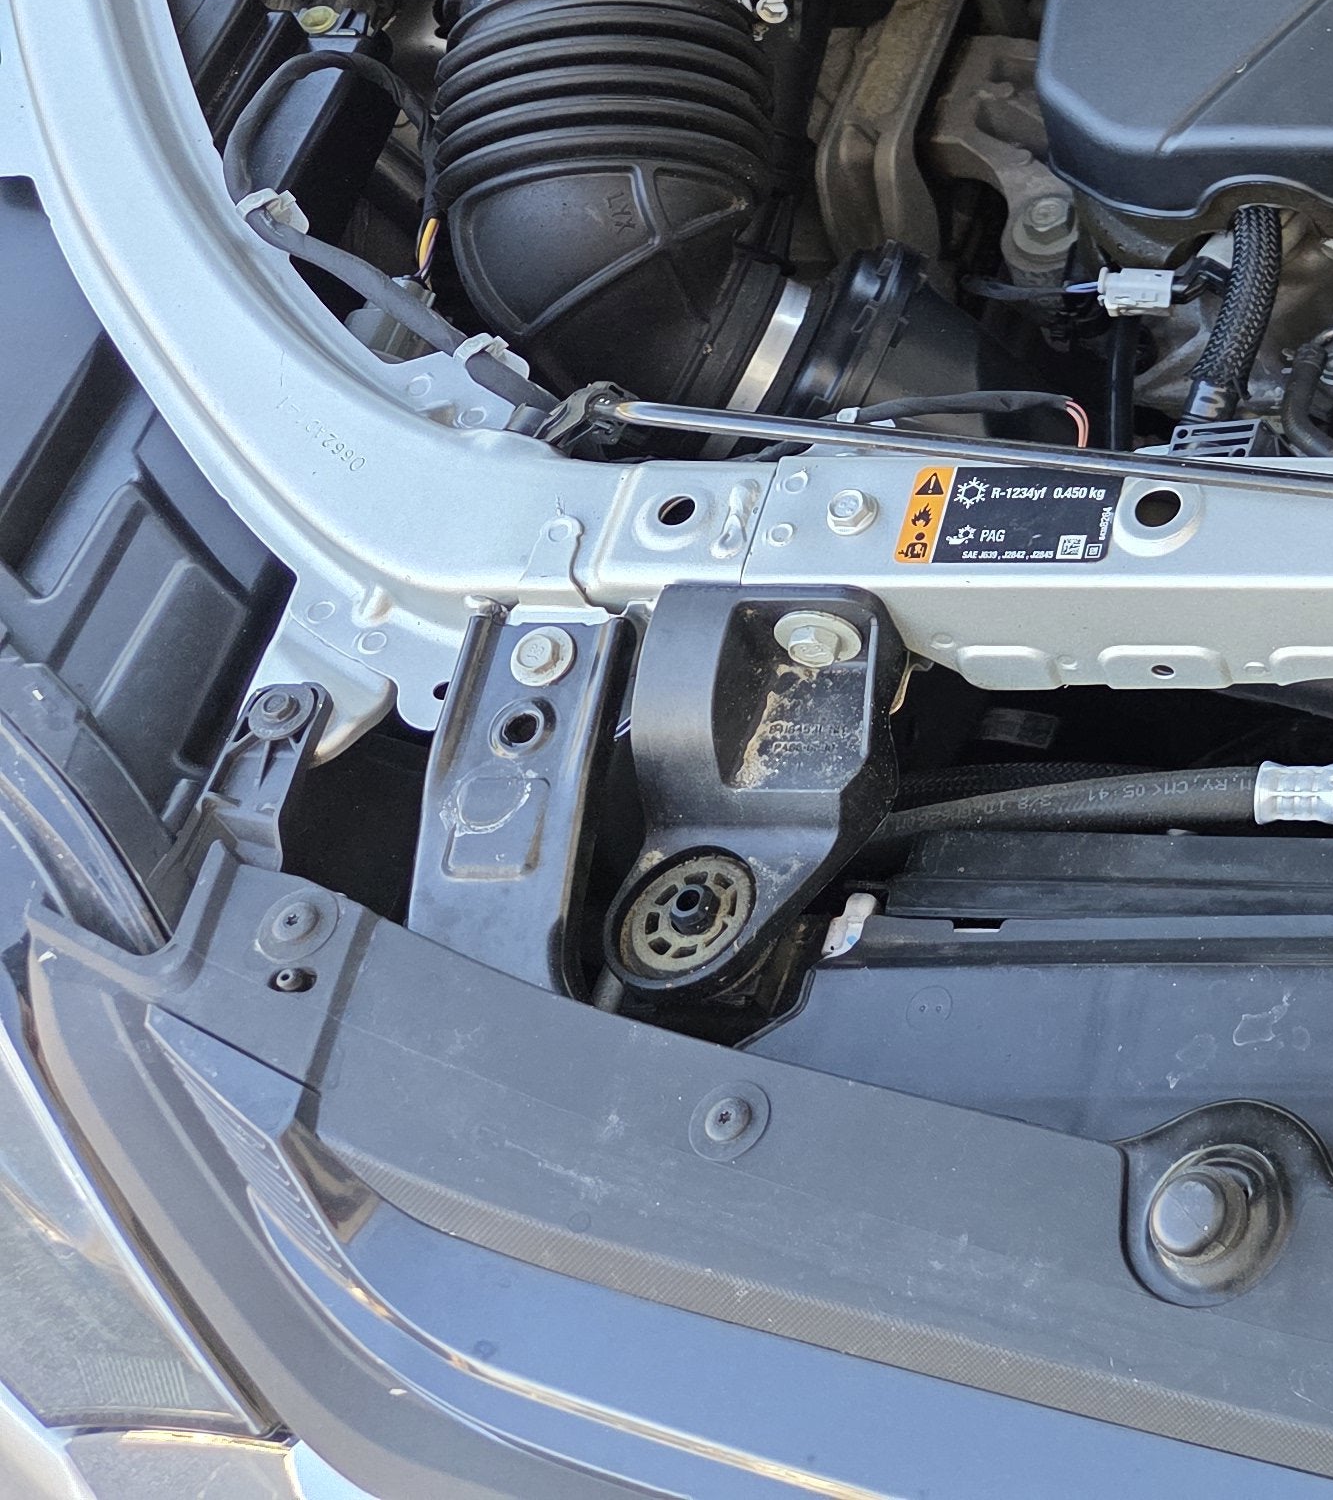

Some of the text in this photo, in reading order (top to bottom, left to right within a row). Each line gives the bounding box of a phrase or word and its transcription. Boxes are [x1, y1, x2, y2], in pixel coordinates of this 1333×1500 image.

[990, 486, 1106, 501] R-1234yf 0.450 kg
[979, 529, 1006, 543] PAG
[961, 550, 979, 559] SAE
